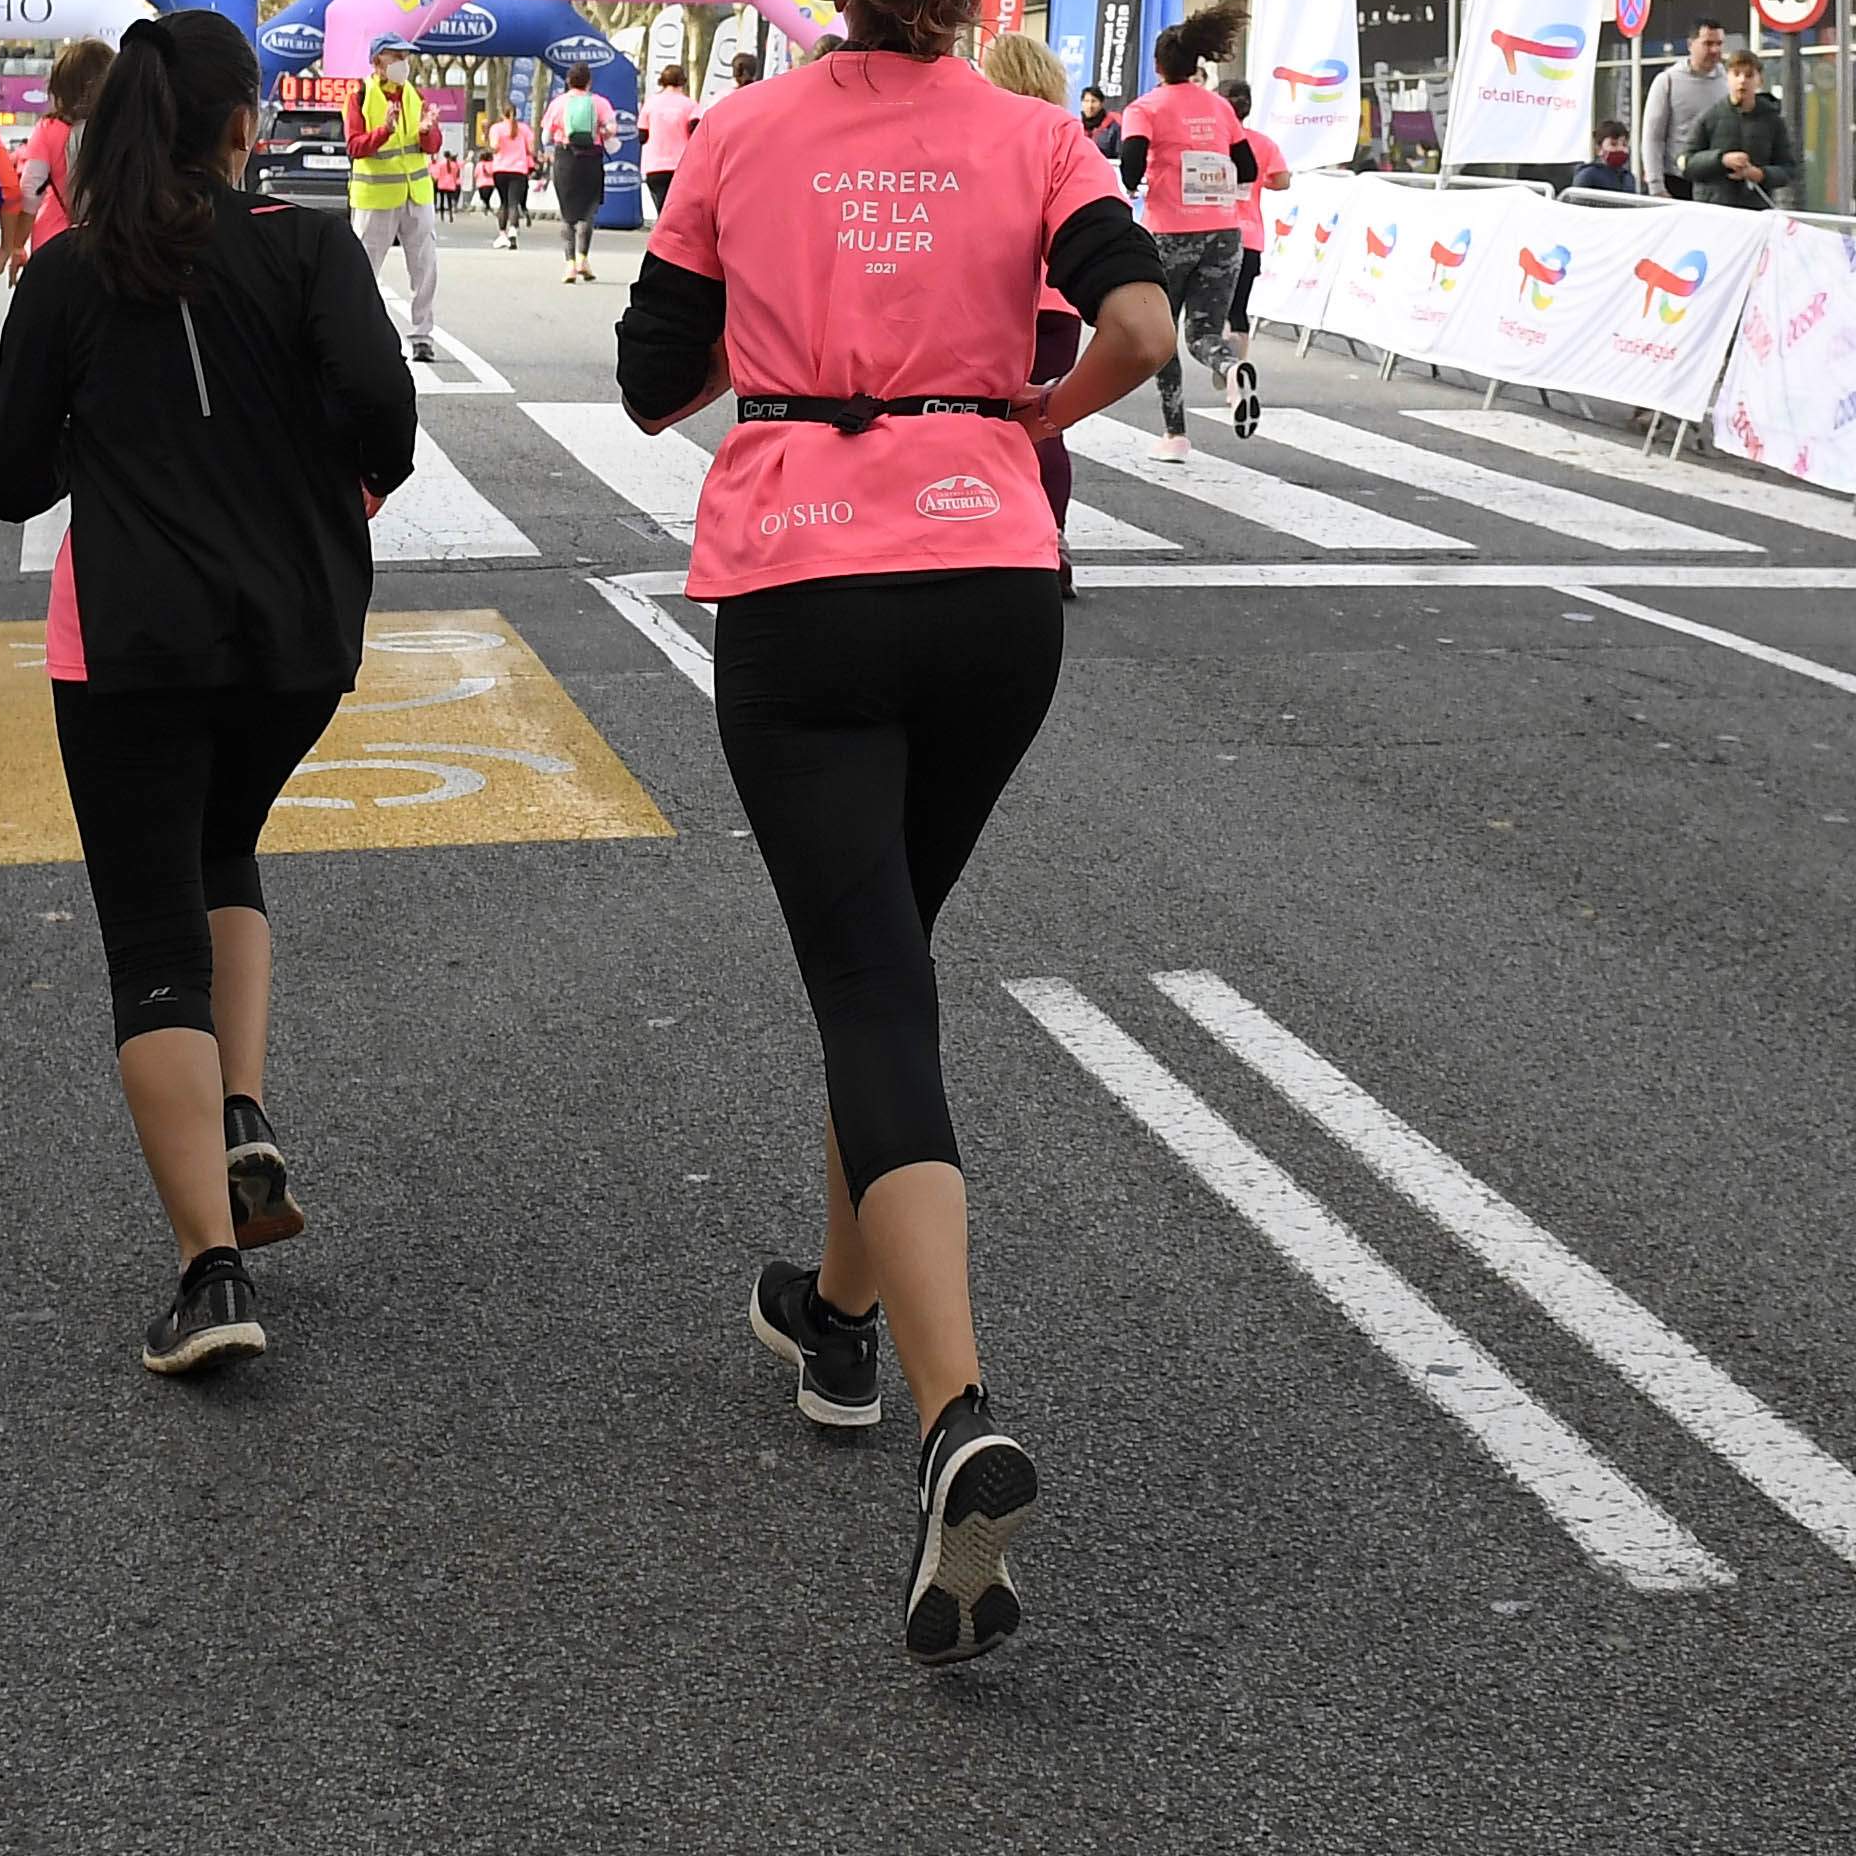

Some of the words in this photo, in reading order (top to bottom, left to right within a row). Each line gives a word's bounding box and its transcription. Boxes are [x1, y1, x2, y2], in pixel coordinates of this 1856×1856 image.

[812, 171, 960, 193] CARRERA
[842, 200, 879, 223] DE
[890, 201, 930, 224] LA
[837, 228, 934, 253] MUJER
[865, 263, 897, 274] 2021
[760, 500, 854, 536] OYSHO
